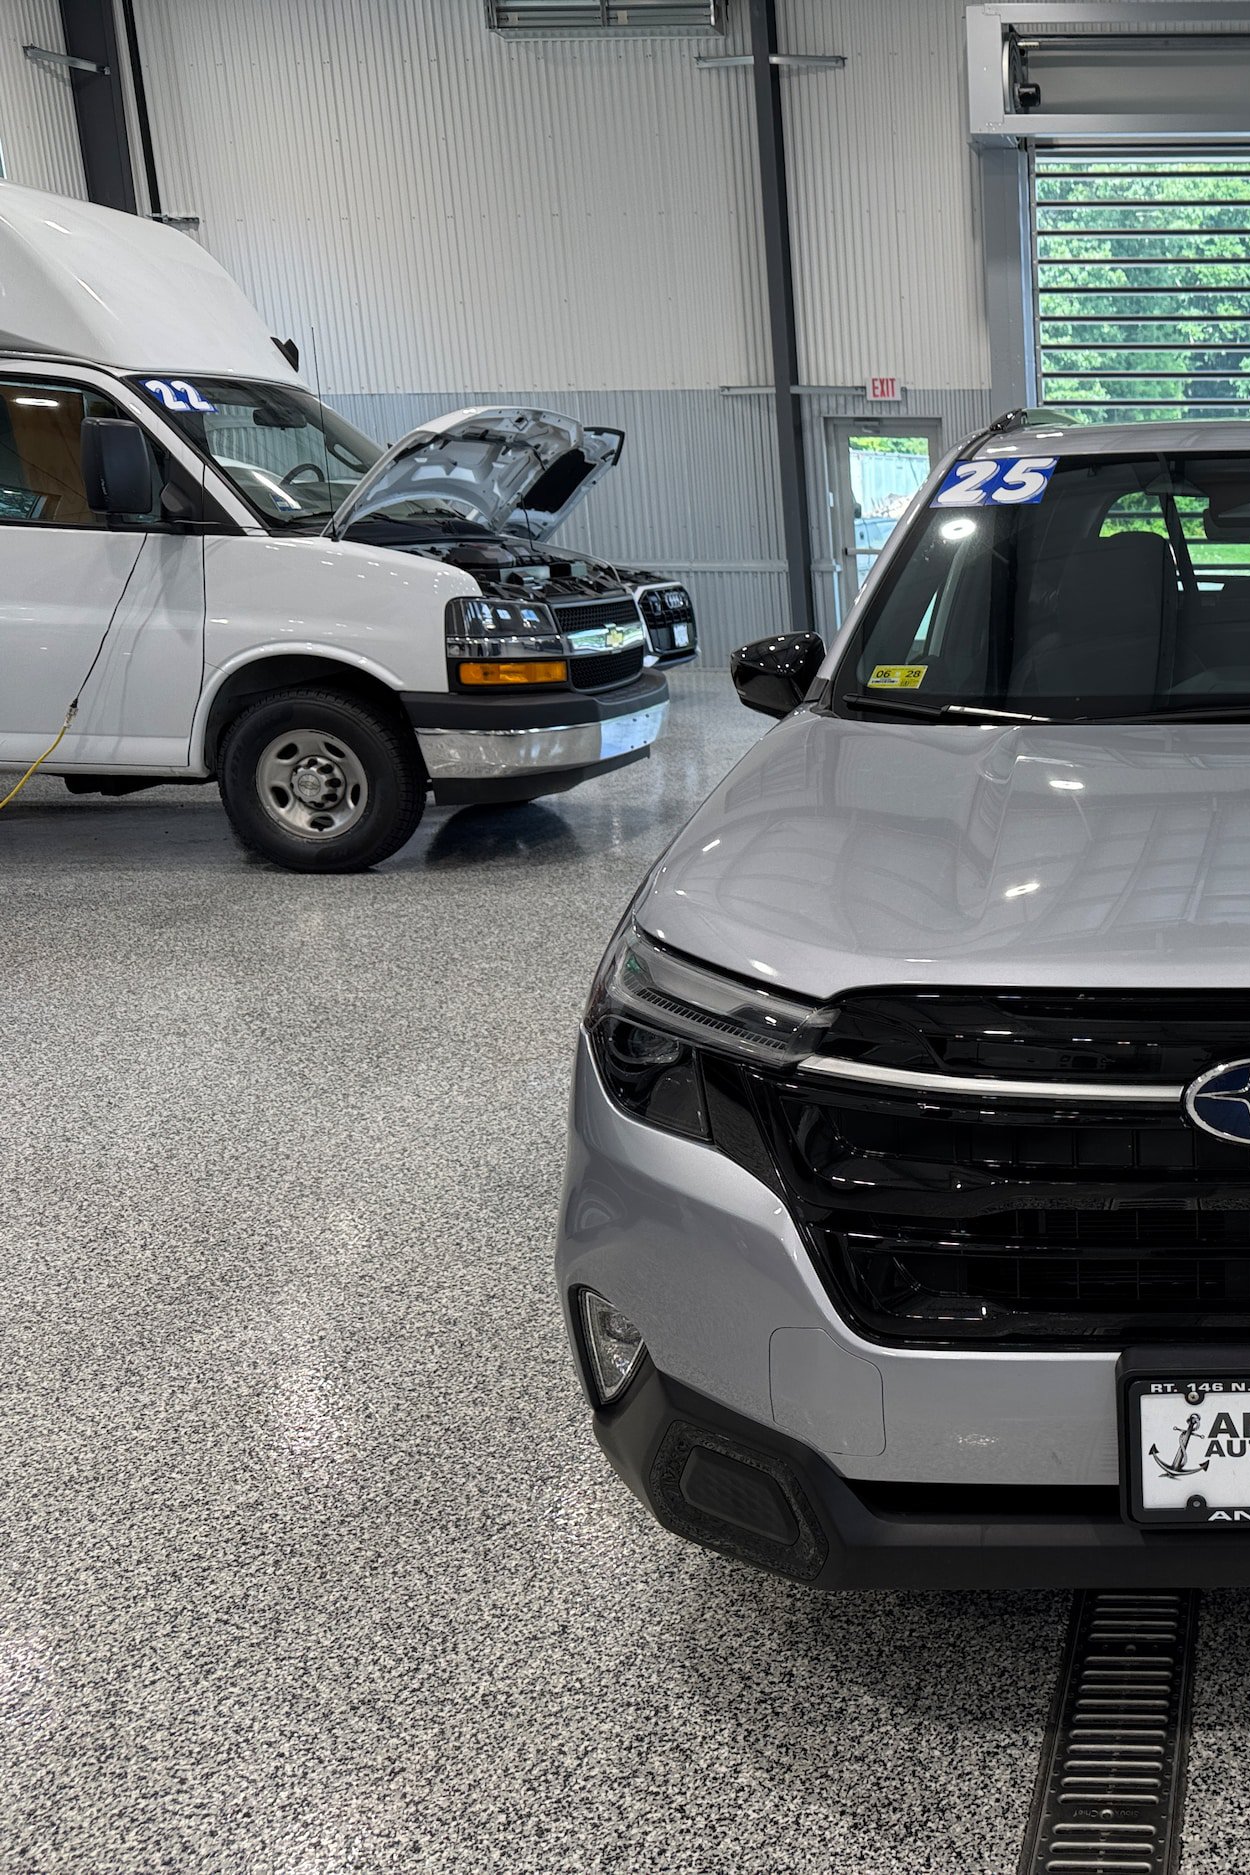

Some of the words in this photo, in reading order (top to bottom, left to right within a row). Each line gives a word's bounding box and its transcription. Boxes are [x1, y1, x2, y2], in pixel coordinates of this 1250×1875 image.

[145, 380, 215, 411] 22
[872, 377, 896, 398] EXIT
[938, 458, 1058, 504] 25
[876, 670, 891, 678] 06
[905, 670, 921, 678] 28
[1150, 1383, 1178, 1393] RT.
[1186, 1382, 1223, 1391] 146
[1231, 1382, 1250, 1391] N.
